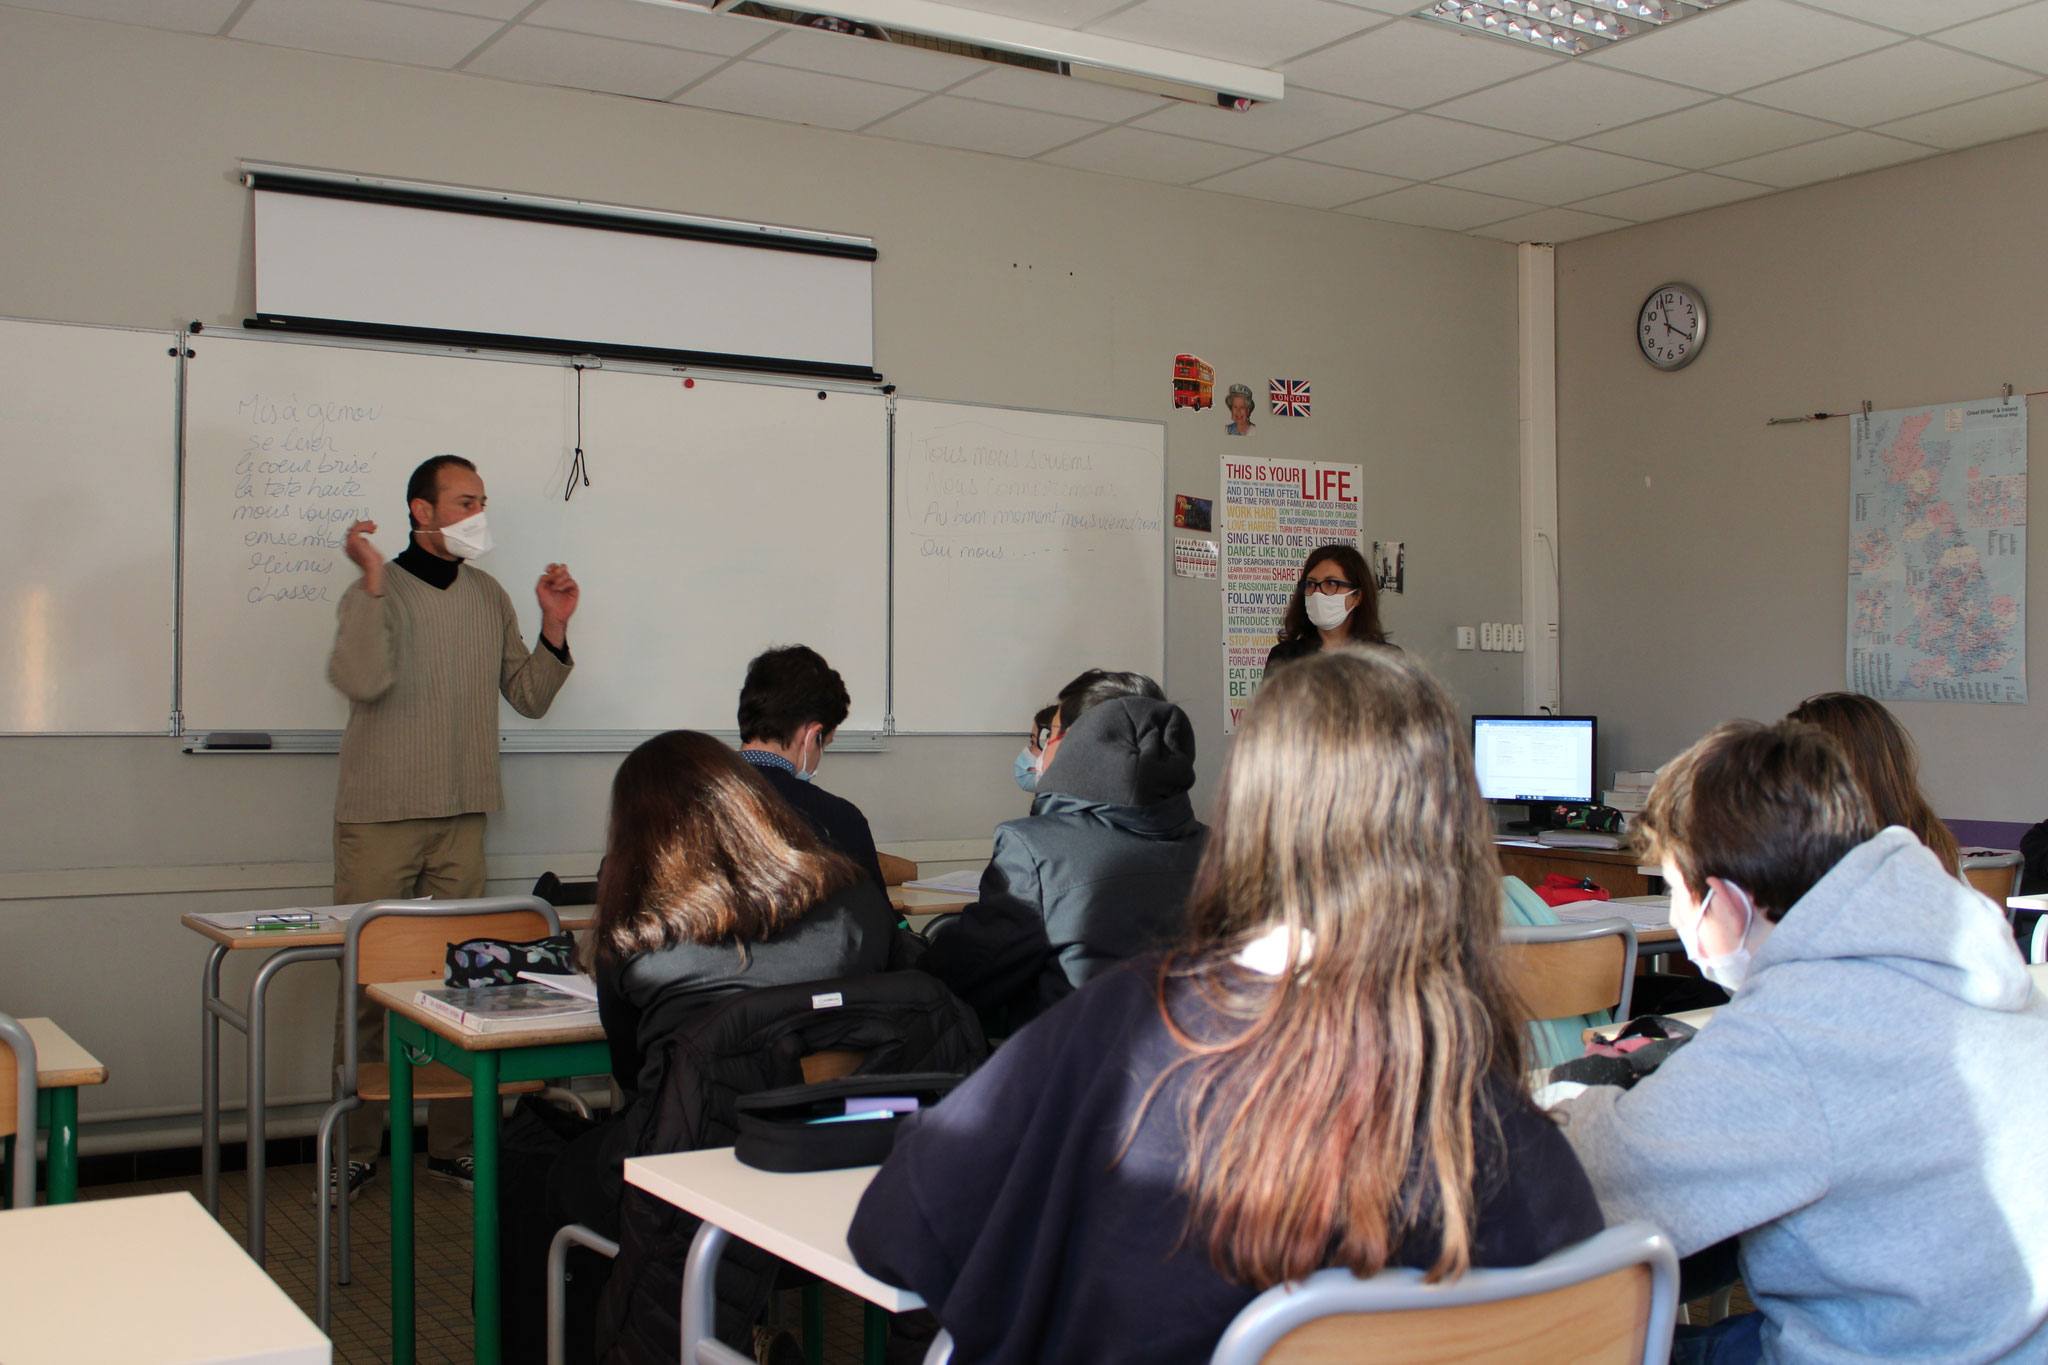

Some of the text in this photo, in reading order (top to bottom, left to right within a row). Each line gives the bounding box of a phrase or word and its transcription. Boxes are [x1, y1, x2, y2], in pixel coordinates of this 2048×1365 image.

[1665, 294, 1674, 304] 12
[1680, 296, 1682, 305] 1
[1656, 300, 1663, 310] 11
[1687, 304, 1693, 314] 2
[1648, 312, 1657, 322] 10
[1690, 318, 1696, 328] 3
[1644, 325, 1651, 335] 9
[1686, 333, 1693, 342] 4
[1648, 338, 1655, 348] 8
[1657, 347, 1664, 357] 7
[1679, 344, 1684, 354] 5
[1667, 350, 1674, 360] 6
[1274, 393, 1307, 403] LONDON
[1225, 463, 1252, 480] THIS
[1255, 465, 1266, 481] IS
[1268, 466, 1300, 483] YOUR
[1302, 468, 1358, 502] LIFE.
[1226, 486, 1242, 496] AND
[1243, 486, 1254, 496] DO
[1255, 487, 1274, 497] THEM
[1226, 496, 1242, 504] MAKE
[1244, 497, 1257, 506] TIME
[1258, 498, 1270, 506] FOR
[1270, 498, 1286, 506] YOUR
[1286, 499, 1305, 508] FAMILY
[1318, 501, 1334, 509] GOOD
[1226, 505, 1252, 518] WORK
[1279, 508, 1294, 516] DON'T
[1318, 510, 1324, 518] TO
[1325, 510, 1334, 518] CRY
[1227, 520, 1246, 530] LOVE
[1279, 516, 1286, 524] BE
[1287, 517, 1308, 526] INSPIRED
[1309, 518, 1318, 526] AND
[1320, 519, 1338, 527] INSPIRE
[1294, 526, 1302, 534] OFF
[1302, 526, 1312, 534] THE
[1330, 528, 1336, 536] GO
[244, 530, 345, 549] ensemb
[1226, 532, 1249, 544] SING
[1251, 533, 1270, 545] LIKE
[1272, 534, 1284, 546] NO
[1286, 535, 1303, 546] ONE
[1305, 536, 1314, 547] IS
[1228, 546, 1256, 556] DANCE
[1258, 546, 1276, 557] LIKE
[1278, 547, 1288, 558] NO
[1291, 548, 1306, 558] ONE
[1244, 558, 1274, 566] SEARCHING
[1272, 568, 1296, 581] SHARE
[1228, 582, 1297, 592] BE PASSIONATE ABOU
[1228, 592, 1264, 604] FOLLOW
[1265, 594, 1287, 605] YOUR
[1228, 606, 1238, 614] LET
[1240, 606, 1256, 614] THEM
[1228, 616, 1270, 626] INTRODUCE
[1229, 636, 1250, 646] STOP
[1228, 656, 1267, 666] FORGIVE AN
[1229, 668, 1248, 680] EAT,
[1230, 682, 1246, 696] BE
